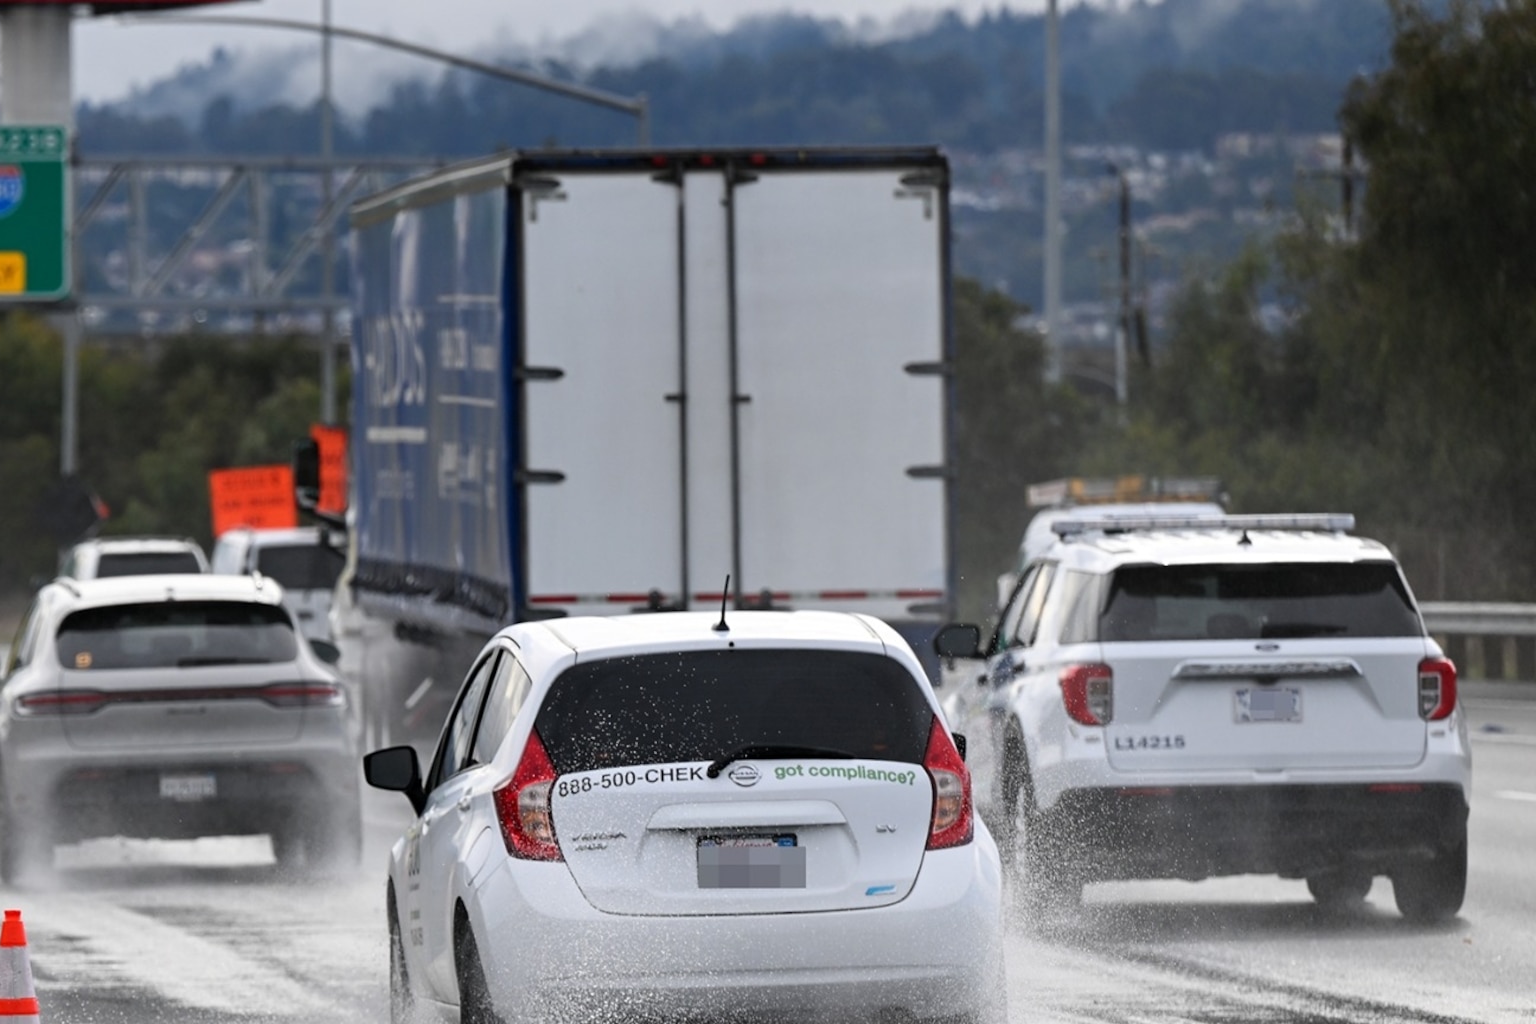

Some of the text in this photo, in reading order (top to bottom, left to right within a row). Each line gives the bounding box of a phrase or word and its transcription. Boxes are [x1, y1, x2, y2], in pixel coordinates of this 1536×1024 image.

[1115, 735, 1186, 751] L14215
[558, 766, 703, 798] 888-500-CHEK
[774, 763, 916, 786] got compliance?
